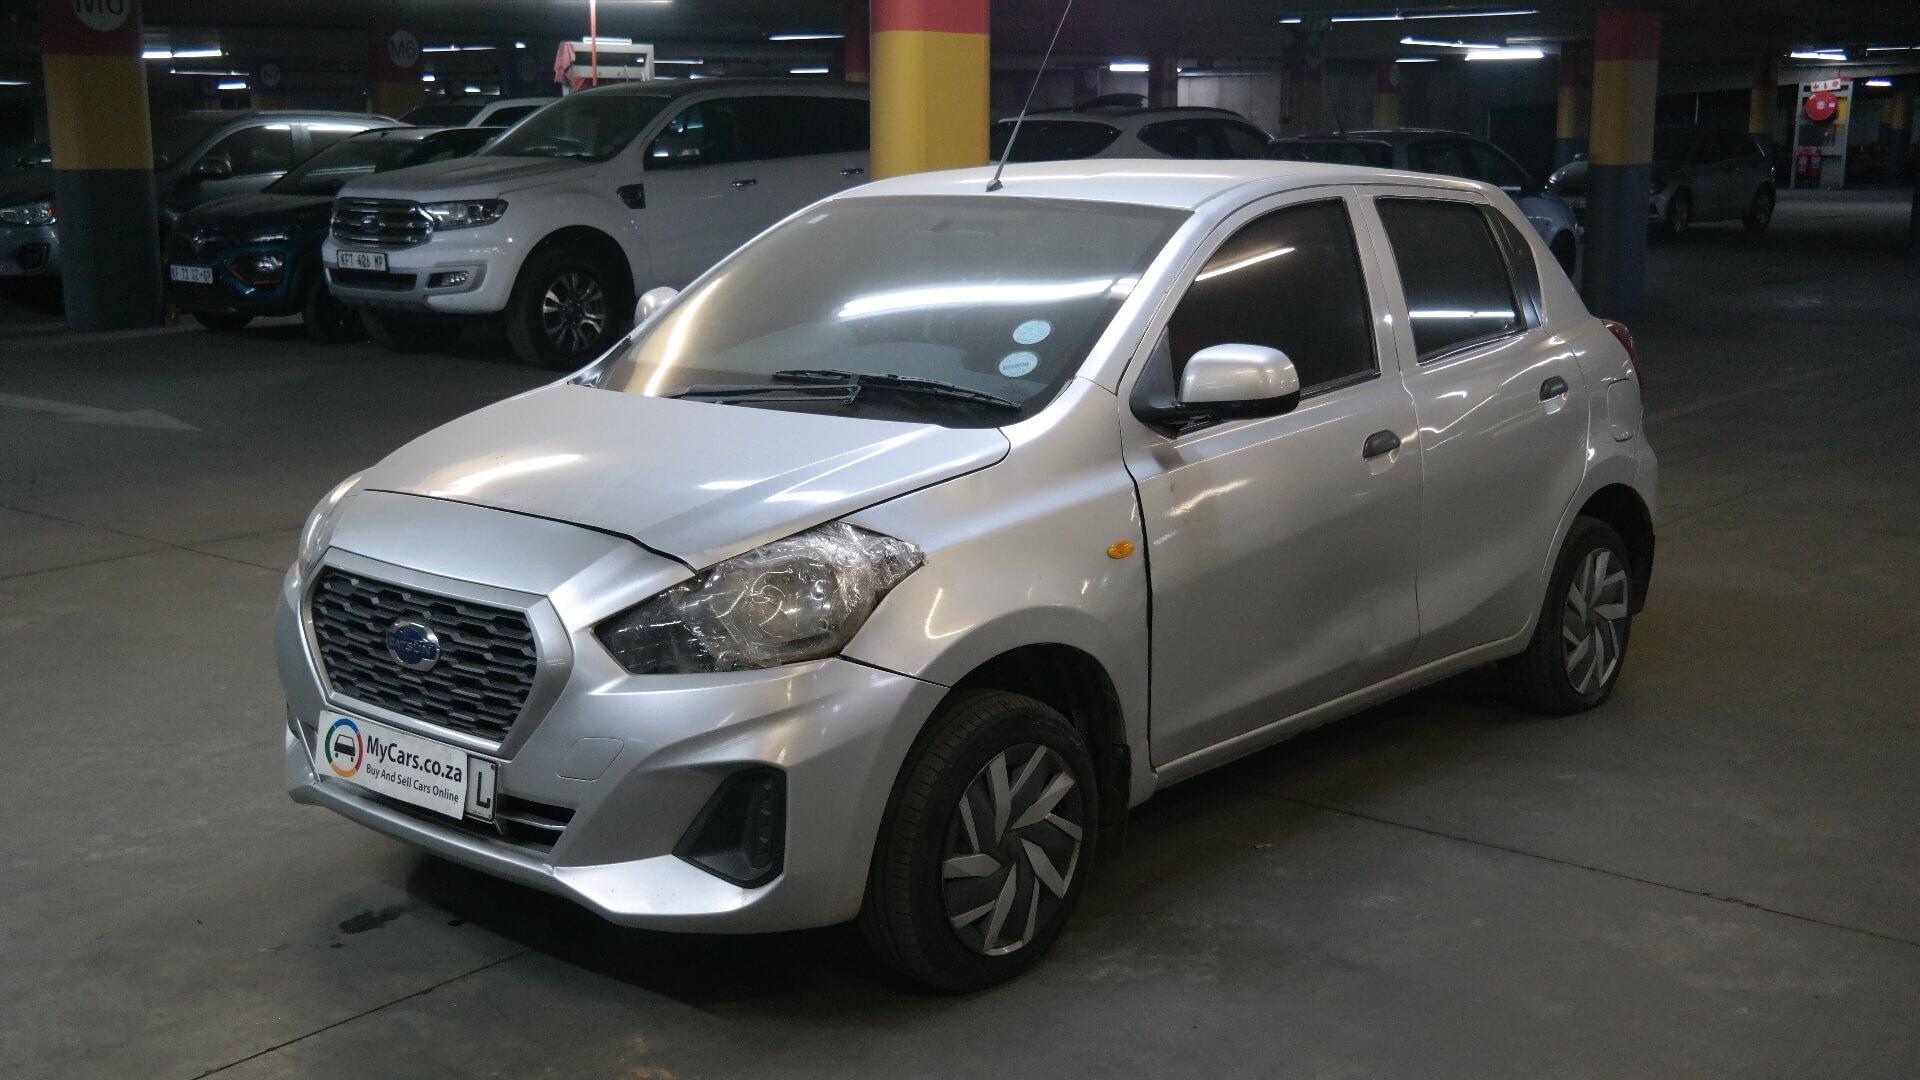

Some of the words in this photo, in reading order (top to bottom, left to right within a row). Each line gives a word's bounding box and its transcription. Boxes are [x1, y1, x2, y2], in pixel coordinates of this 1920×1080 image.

[391, 40, 416, 57] M6
[366, 735, 462, 783] MyCars.co.za
[366, 763, 380, 779] Buy
[380, 769, 396, 783] And
[397, 774, 412, 788] Sell
[413, 779, 431, 794] Cars
[432, 785, 459, 803] Online
